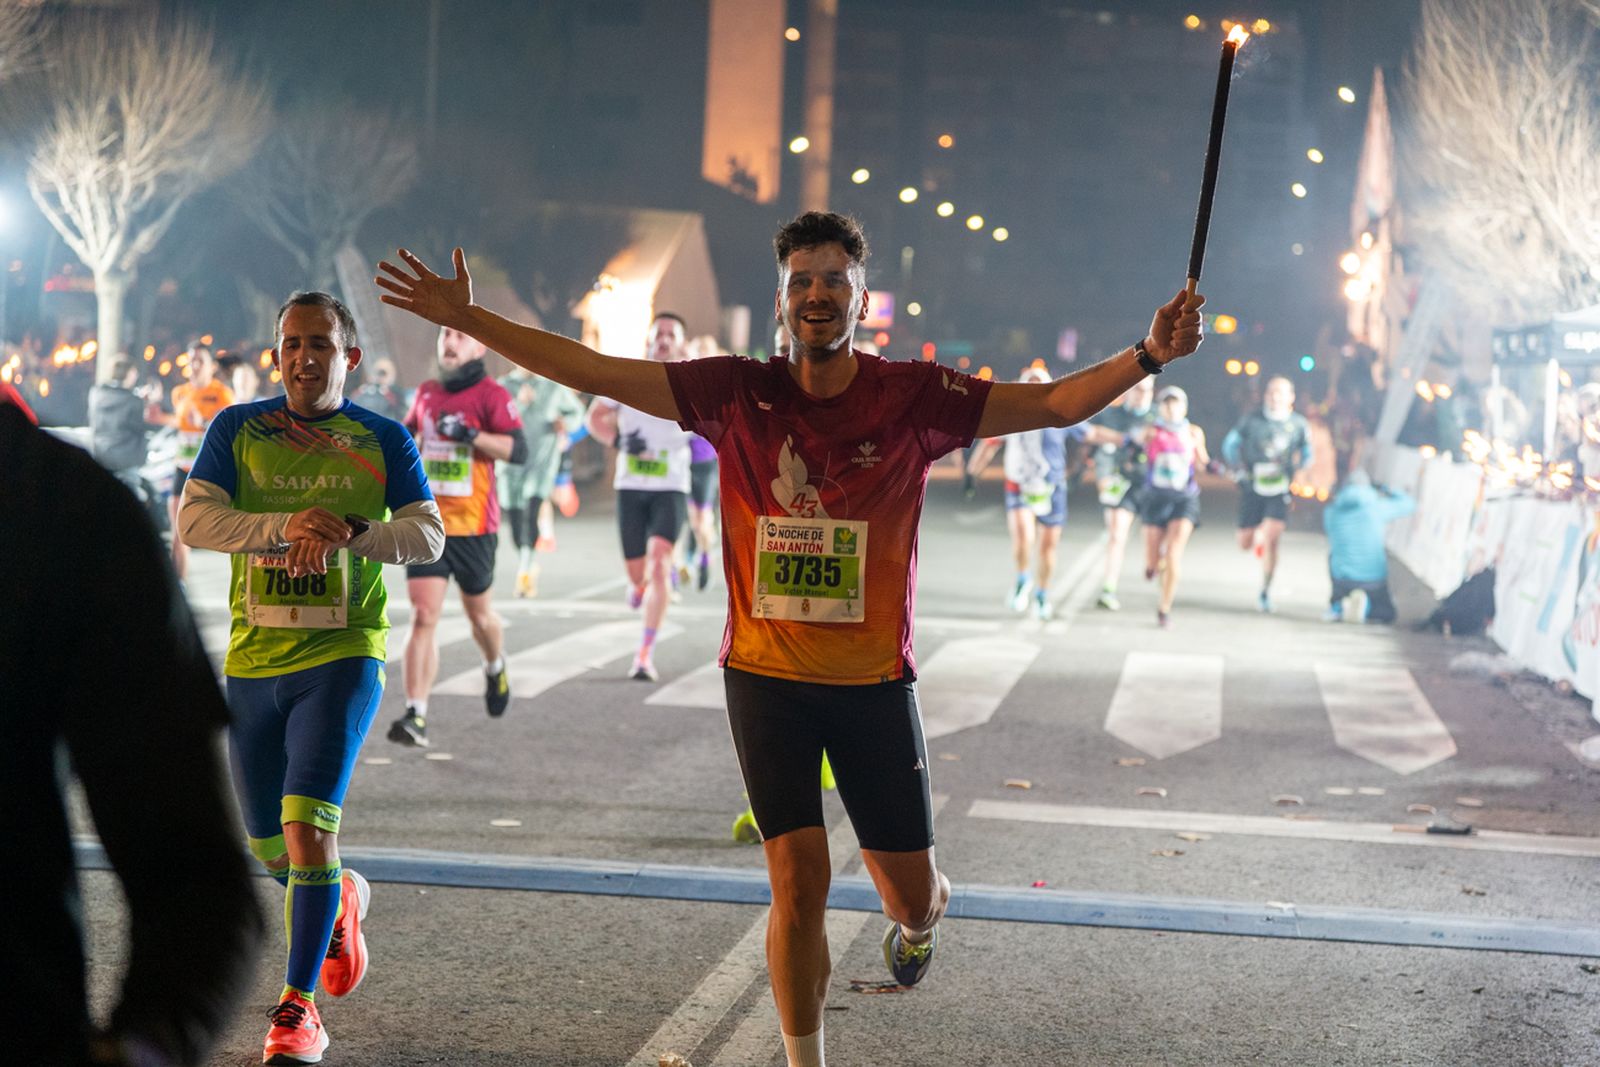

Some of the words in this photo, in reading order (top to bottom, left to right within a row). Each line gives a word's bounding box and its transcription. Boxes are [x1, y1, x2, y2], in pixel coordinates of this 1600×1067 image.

[272, 474, 353, 489] SAKATA
[778, 529, 809, 540] NOCHE
[811, 531, 824, 541] DE
[767, 540, 786, 552] SAN
[788, 540, 824, 553] ANTÓN
[775, 555, 841, 587] 3735
[263, 567, 327, 597] 7808
